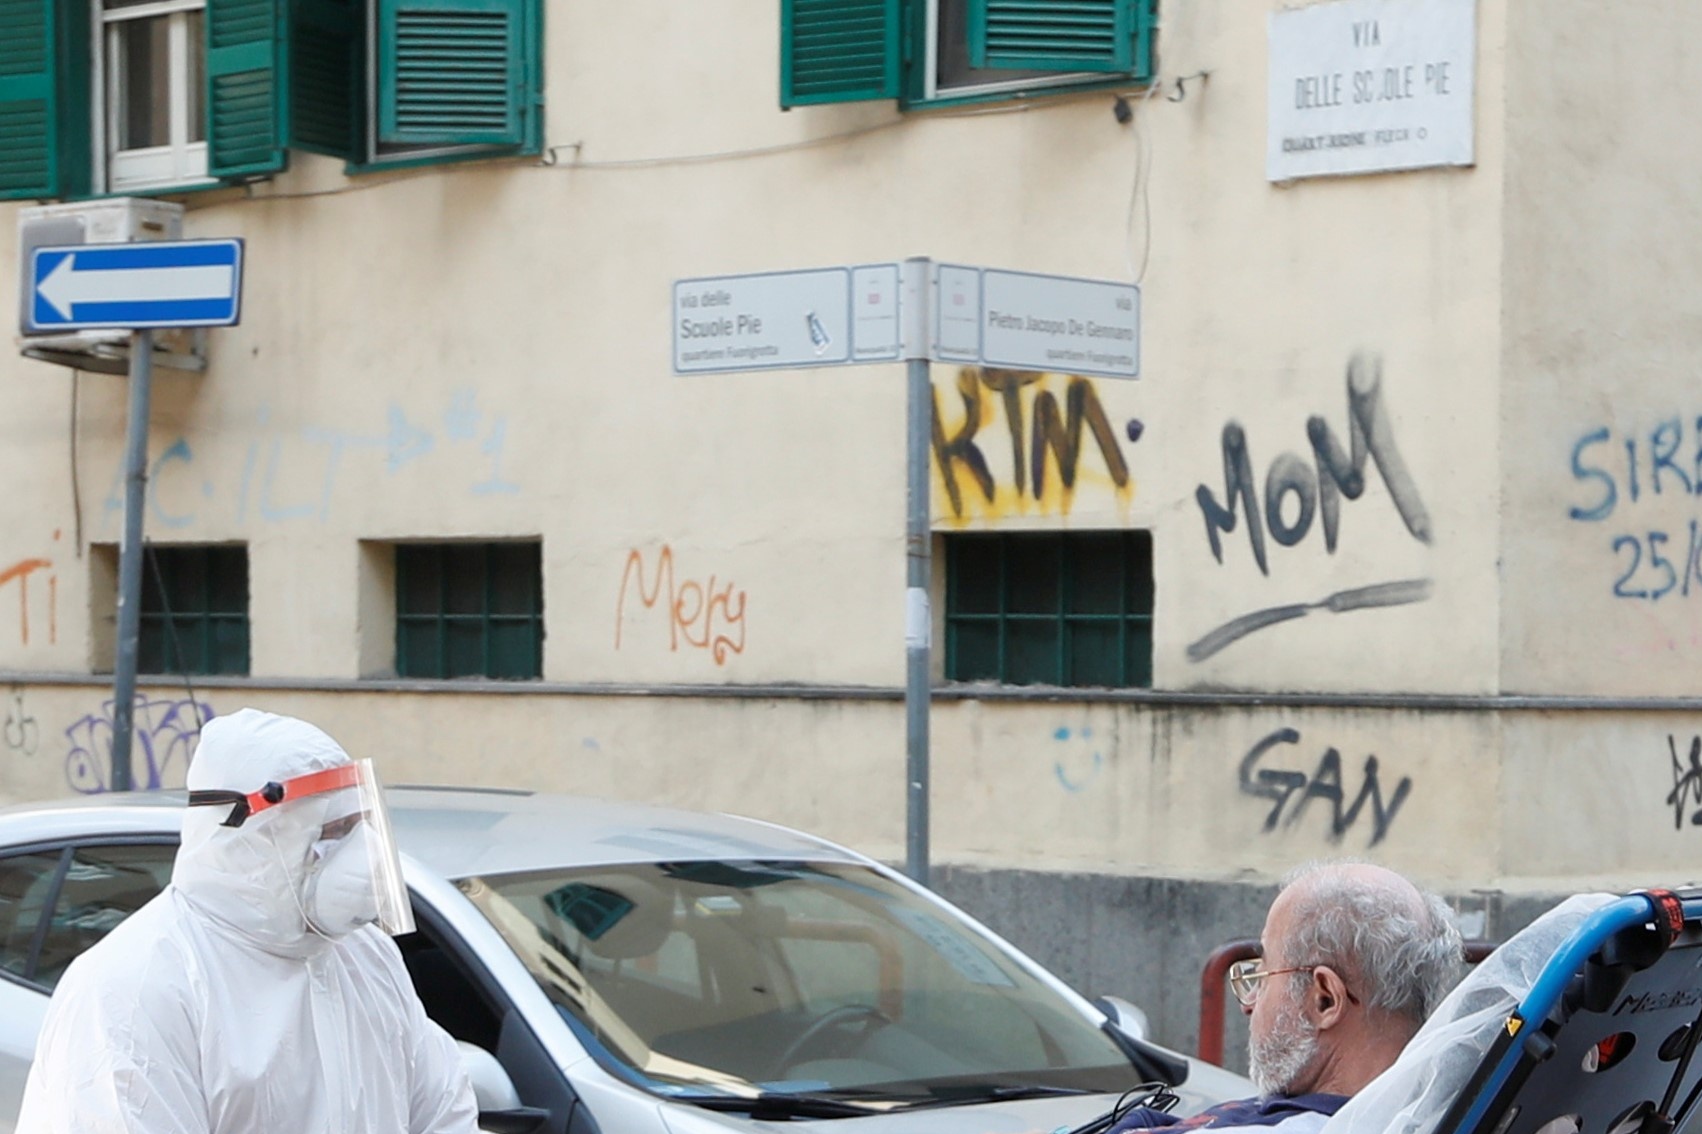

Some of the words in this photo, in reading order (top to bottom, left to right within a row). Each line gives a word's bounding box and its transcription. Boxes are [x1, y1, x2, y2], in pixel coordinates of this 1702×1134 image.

[1352, 20, 1381, 48] VIA
[1295, 73, 1343, 110] DELLE
[1425, 61, 1451, 95] PIE
[680, 291, 698, 308] via
[701, 289, 732, 307] delle
[681, 316, 733, 339] Scuole
[737, 314, 762, 335] Pie
[988, 311, 1024, 330] Pietro
[1025, 315, 1066, 336] Jacopo
[1068, 318, 1086, 336] De
[1196, 350, 1434, 577] MOM
